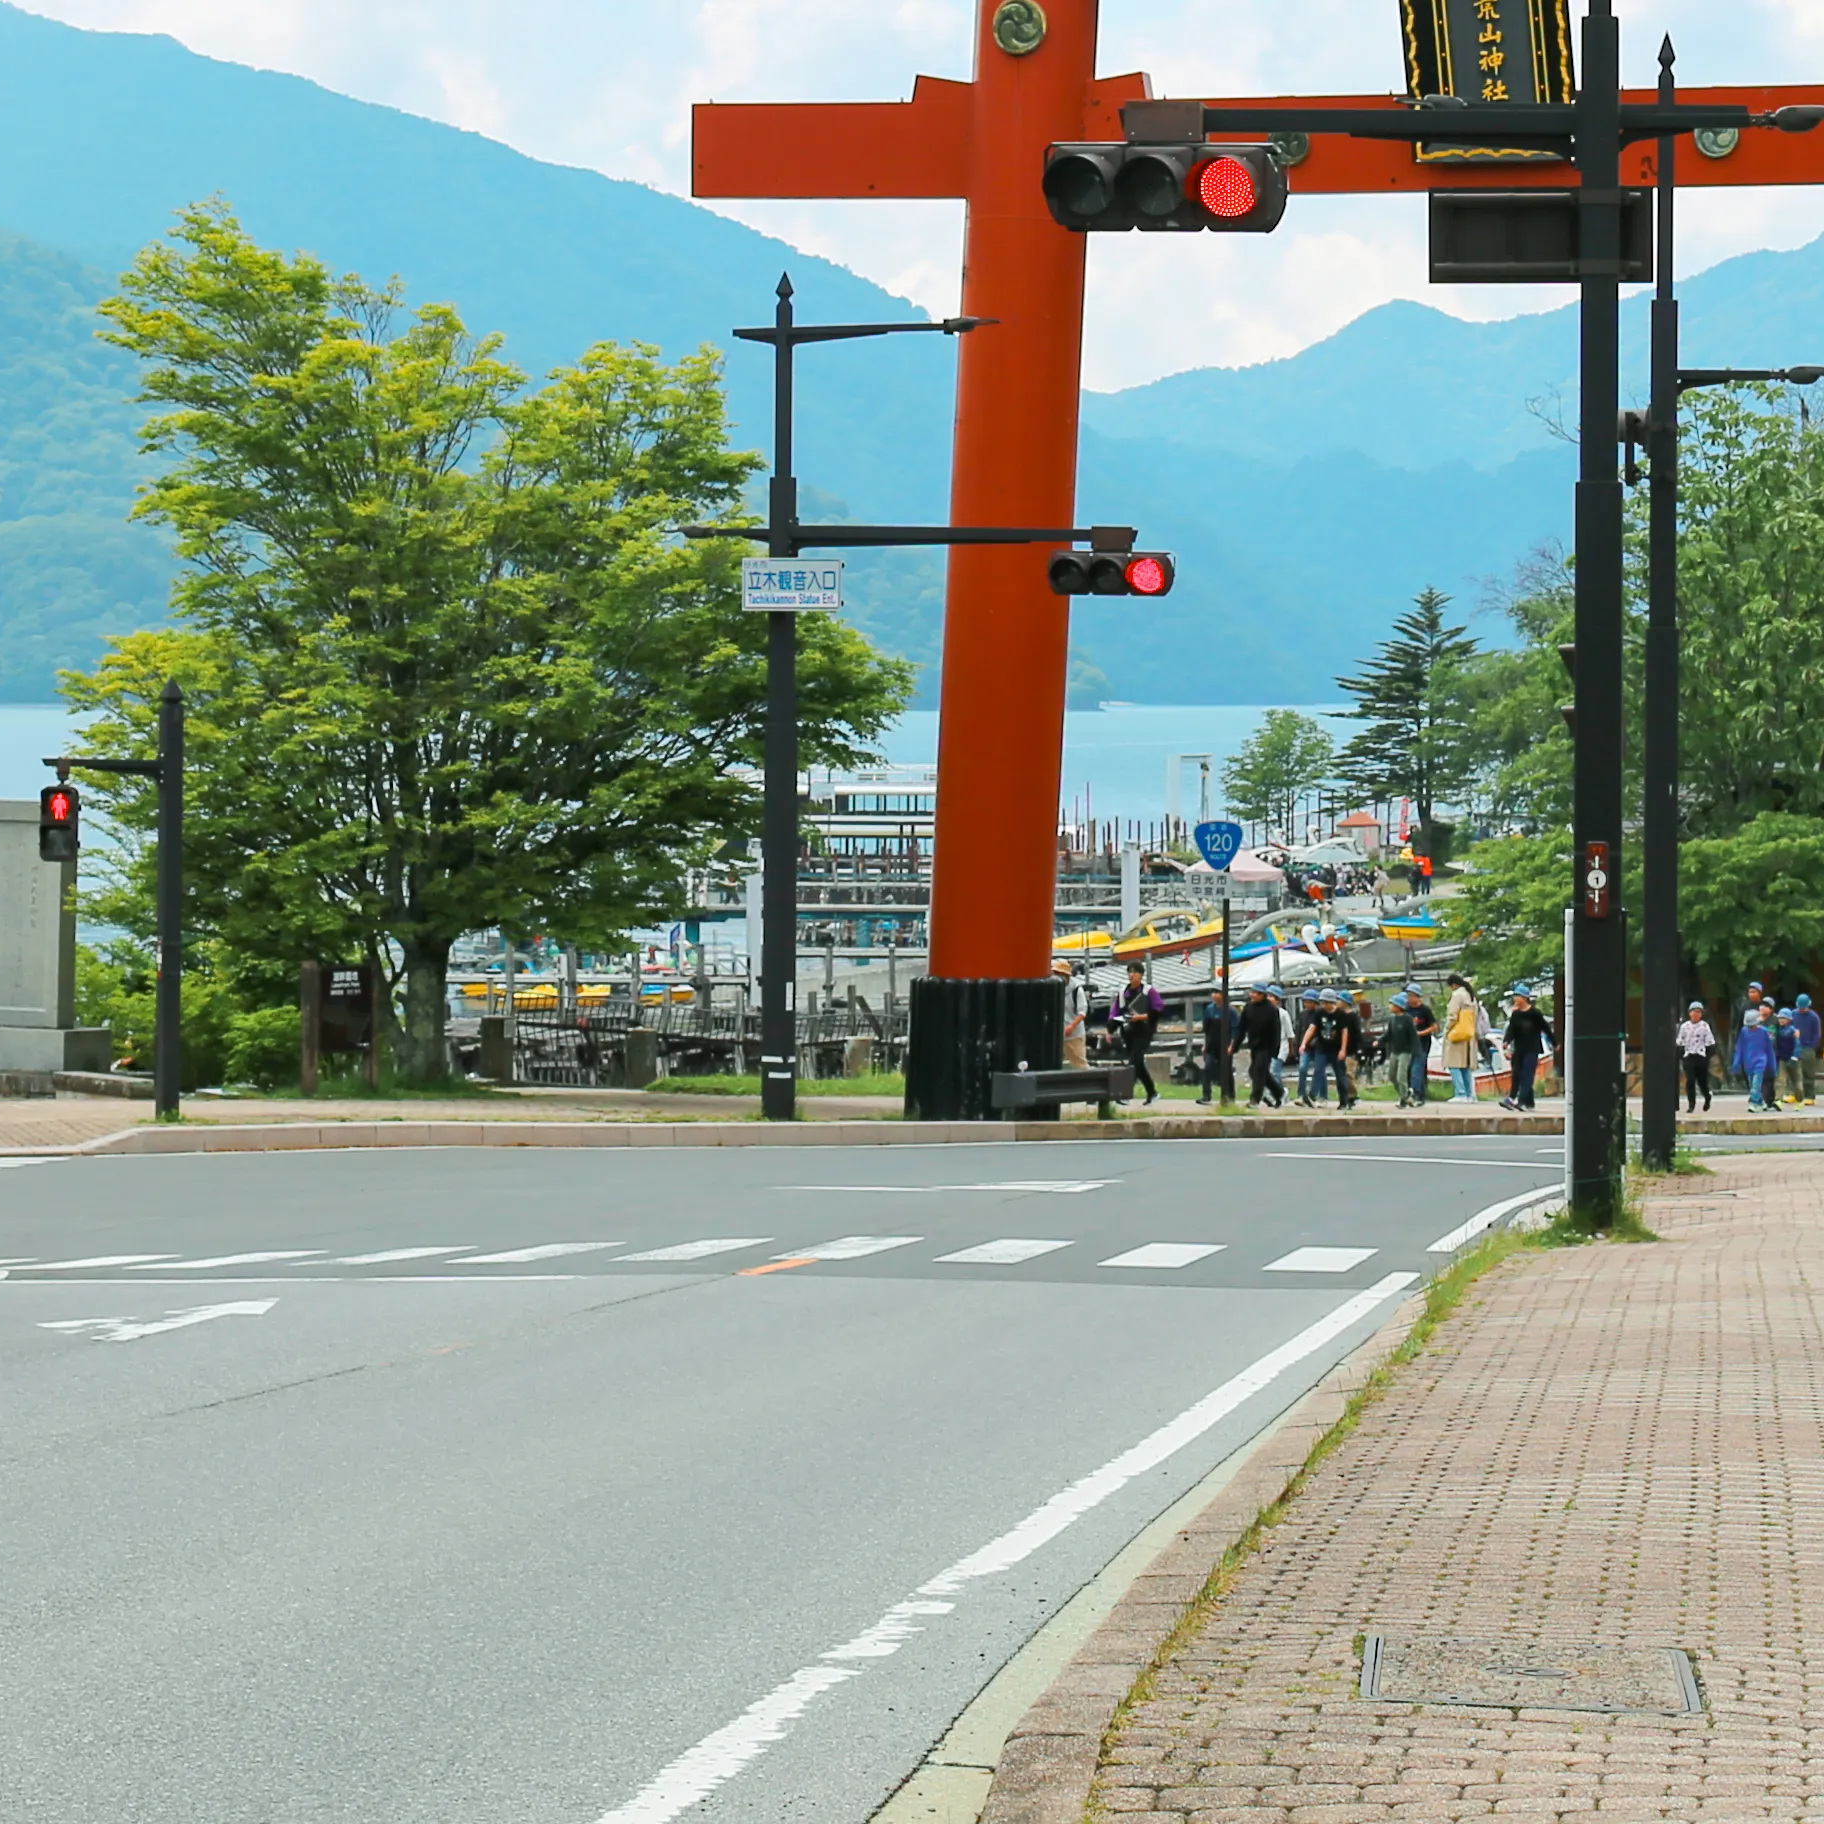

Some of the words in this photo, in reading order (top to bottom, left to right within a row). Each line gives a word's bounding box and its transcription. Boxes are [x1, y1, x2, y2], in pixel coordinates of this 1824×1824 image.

[748, 570, 836, 591] 立木観音入口
[1204, 833, 1233, 852] 120
[1191, 874, 1227, 885] 日光市
